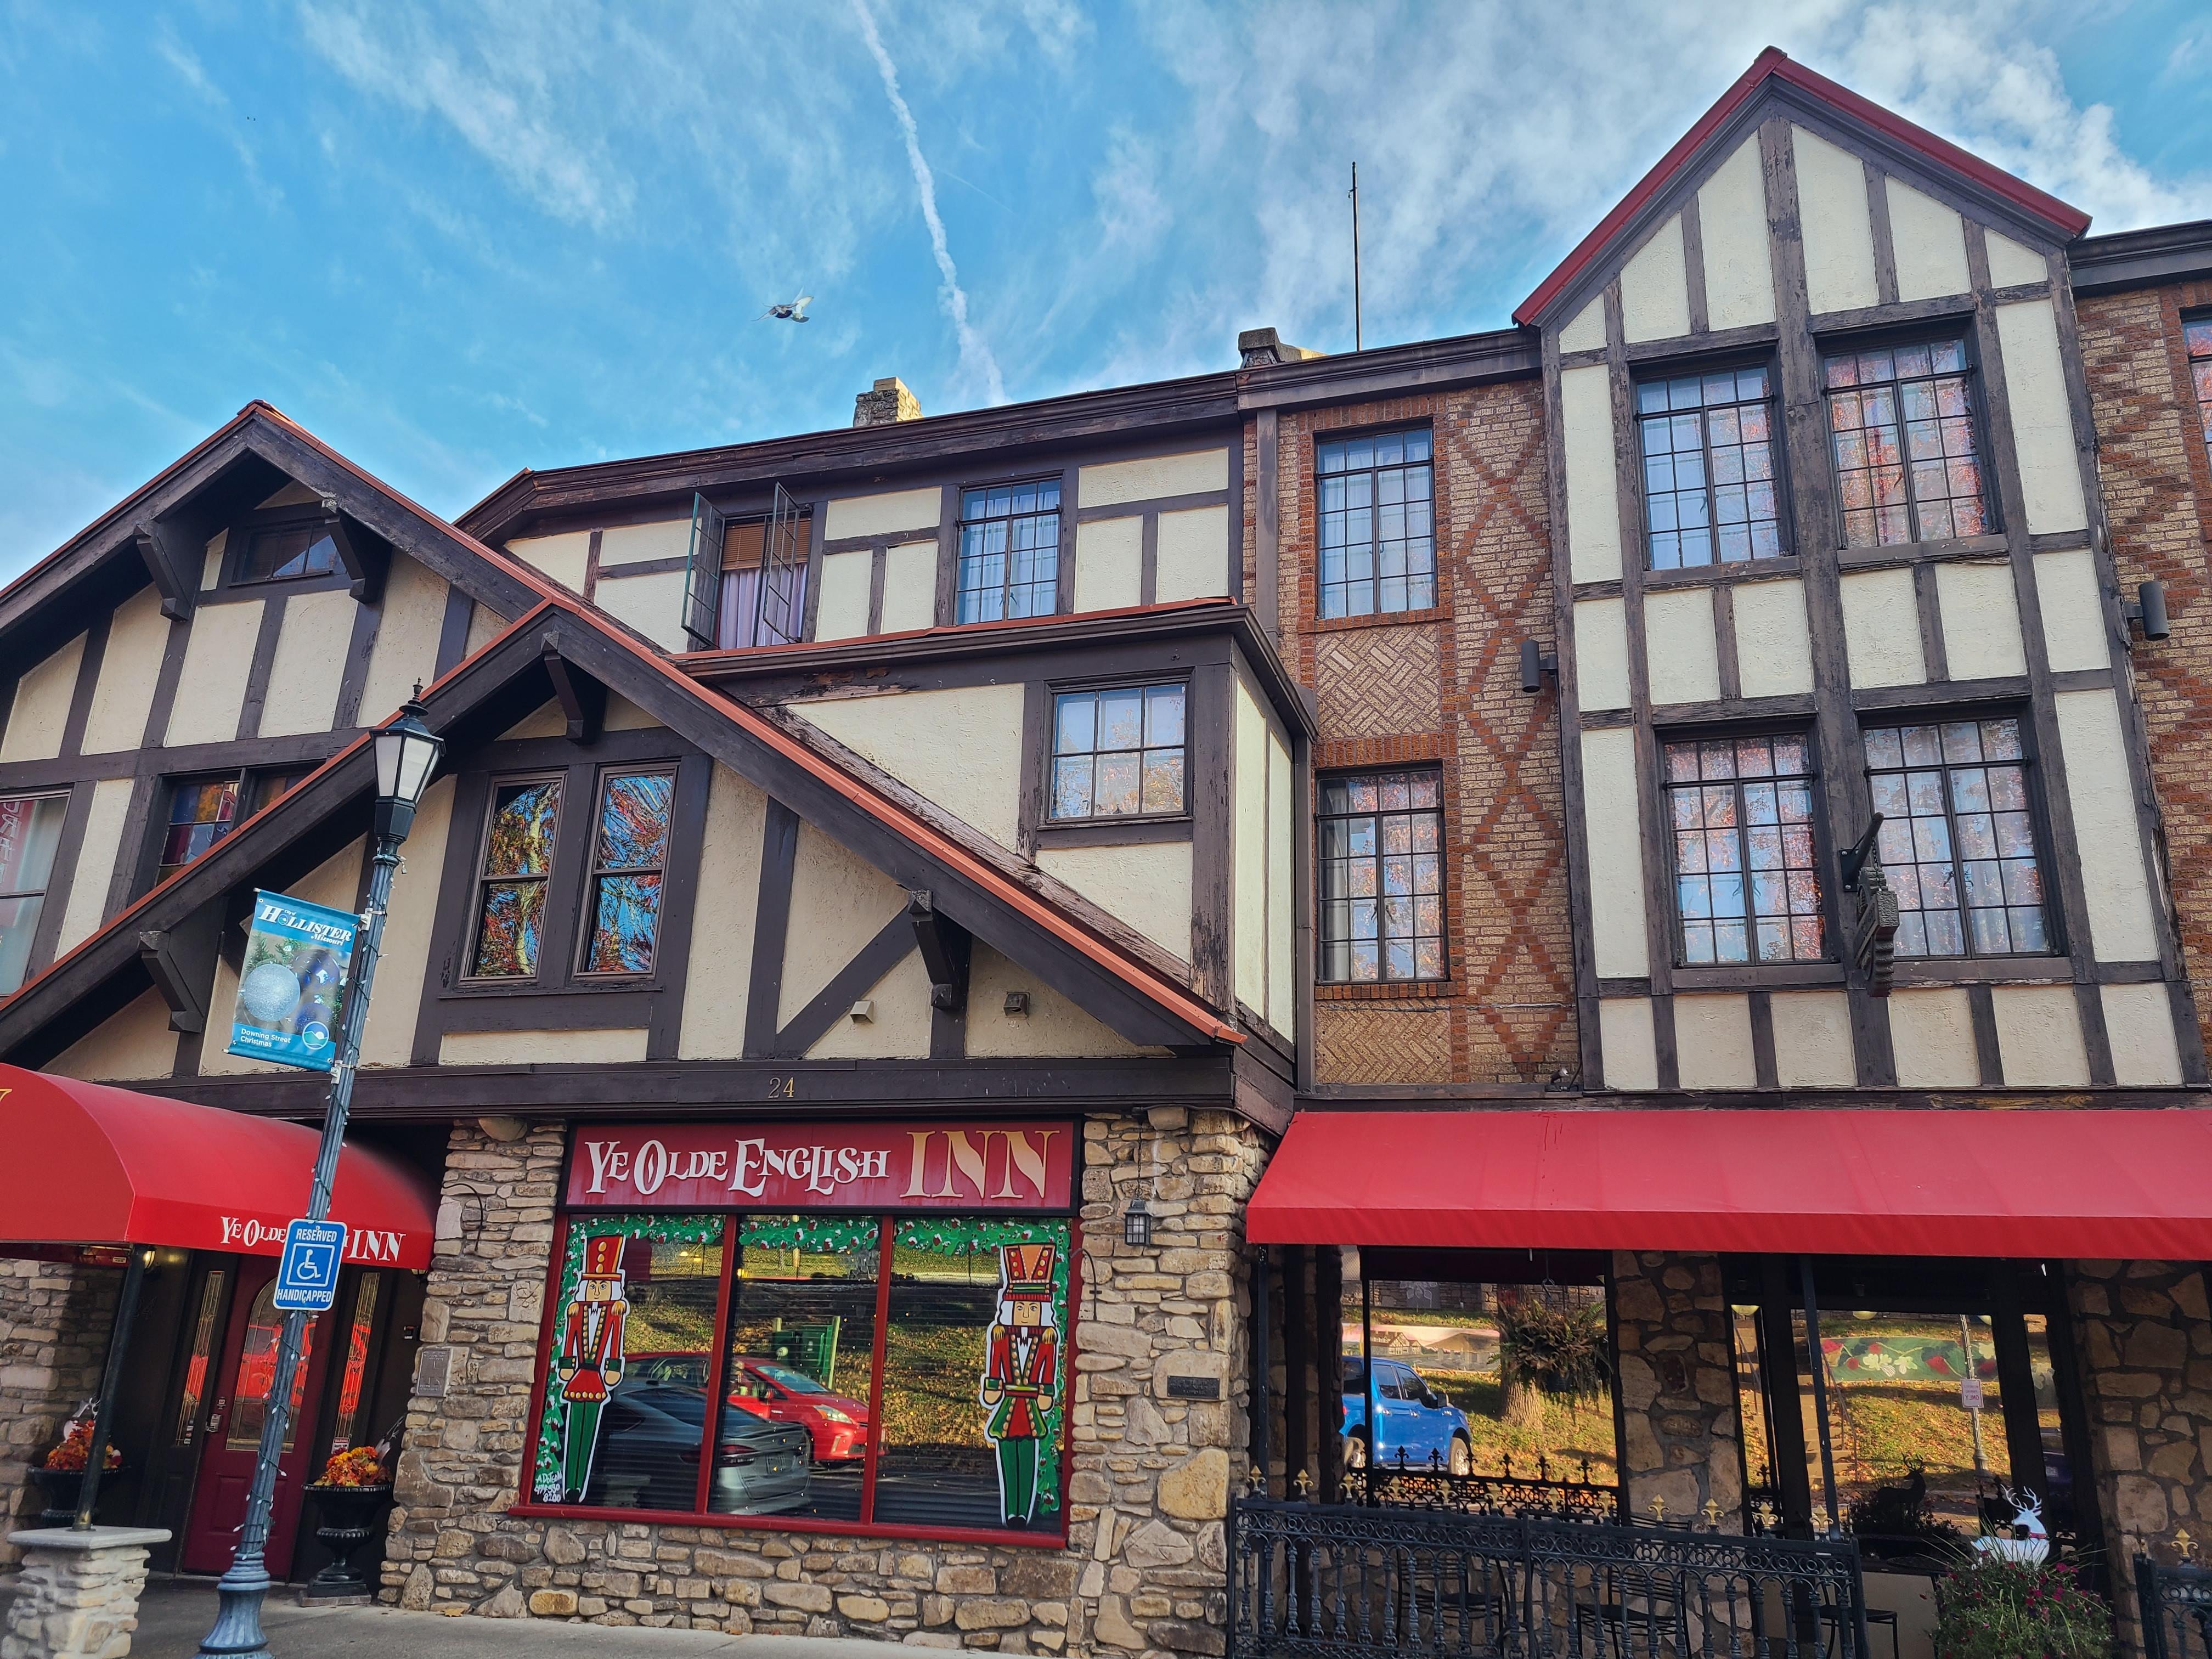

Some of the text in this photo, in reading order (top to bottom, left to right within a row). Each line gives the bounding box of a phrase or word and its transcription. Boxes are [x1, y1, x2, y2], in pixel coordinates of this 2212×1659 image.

[258, 905, 352, 941] HOLLISTER
[311, 933, 345, 946] Missouri
[241, 1028, 291, 1043] Downing Street
[241, 1036, 272, 1047] Christmas
[768, 1077, 794, 1098] 24
[900, 1130, 1060, 1199] INN
[296, 1228, 337, 1242] RESERVED
[347, 1229, 407, 1262] INN
[276, 1288, 332, 1303] HANDICAPPED
[543, 1492, 561, 1503] 8200
